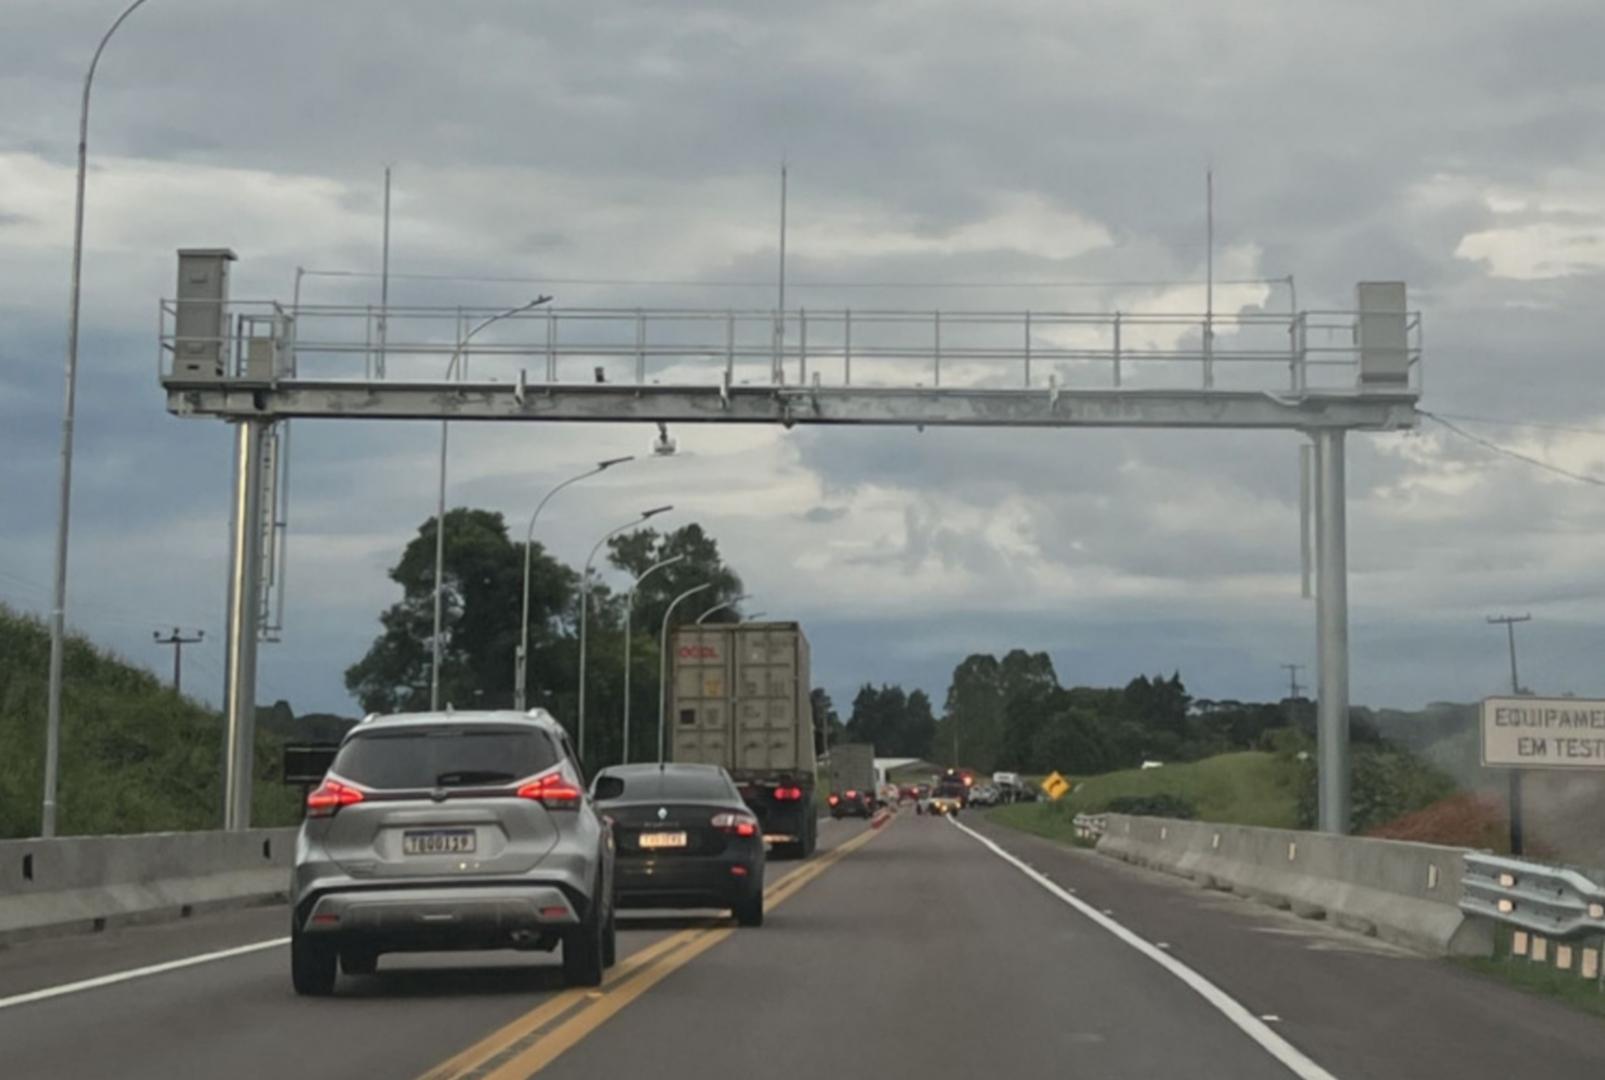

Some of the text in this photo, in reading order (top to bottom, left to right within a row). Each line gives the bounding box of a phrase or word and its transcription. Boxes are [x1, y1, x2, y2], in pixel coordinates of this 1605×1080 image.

[1495, 707, 1605, 729] EQUIPAME
[1518, 737, 1605, 758] EM TEST
